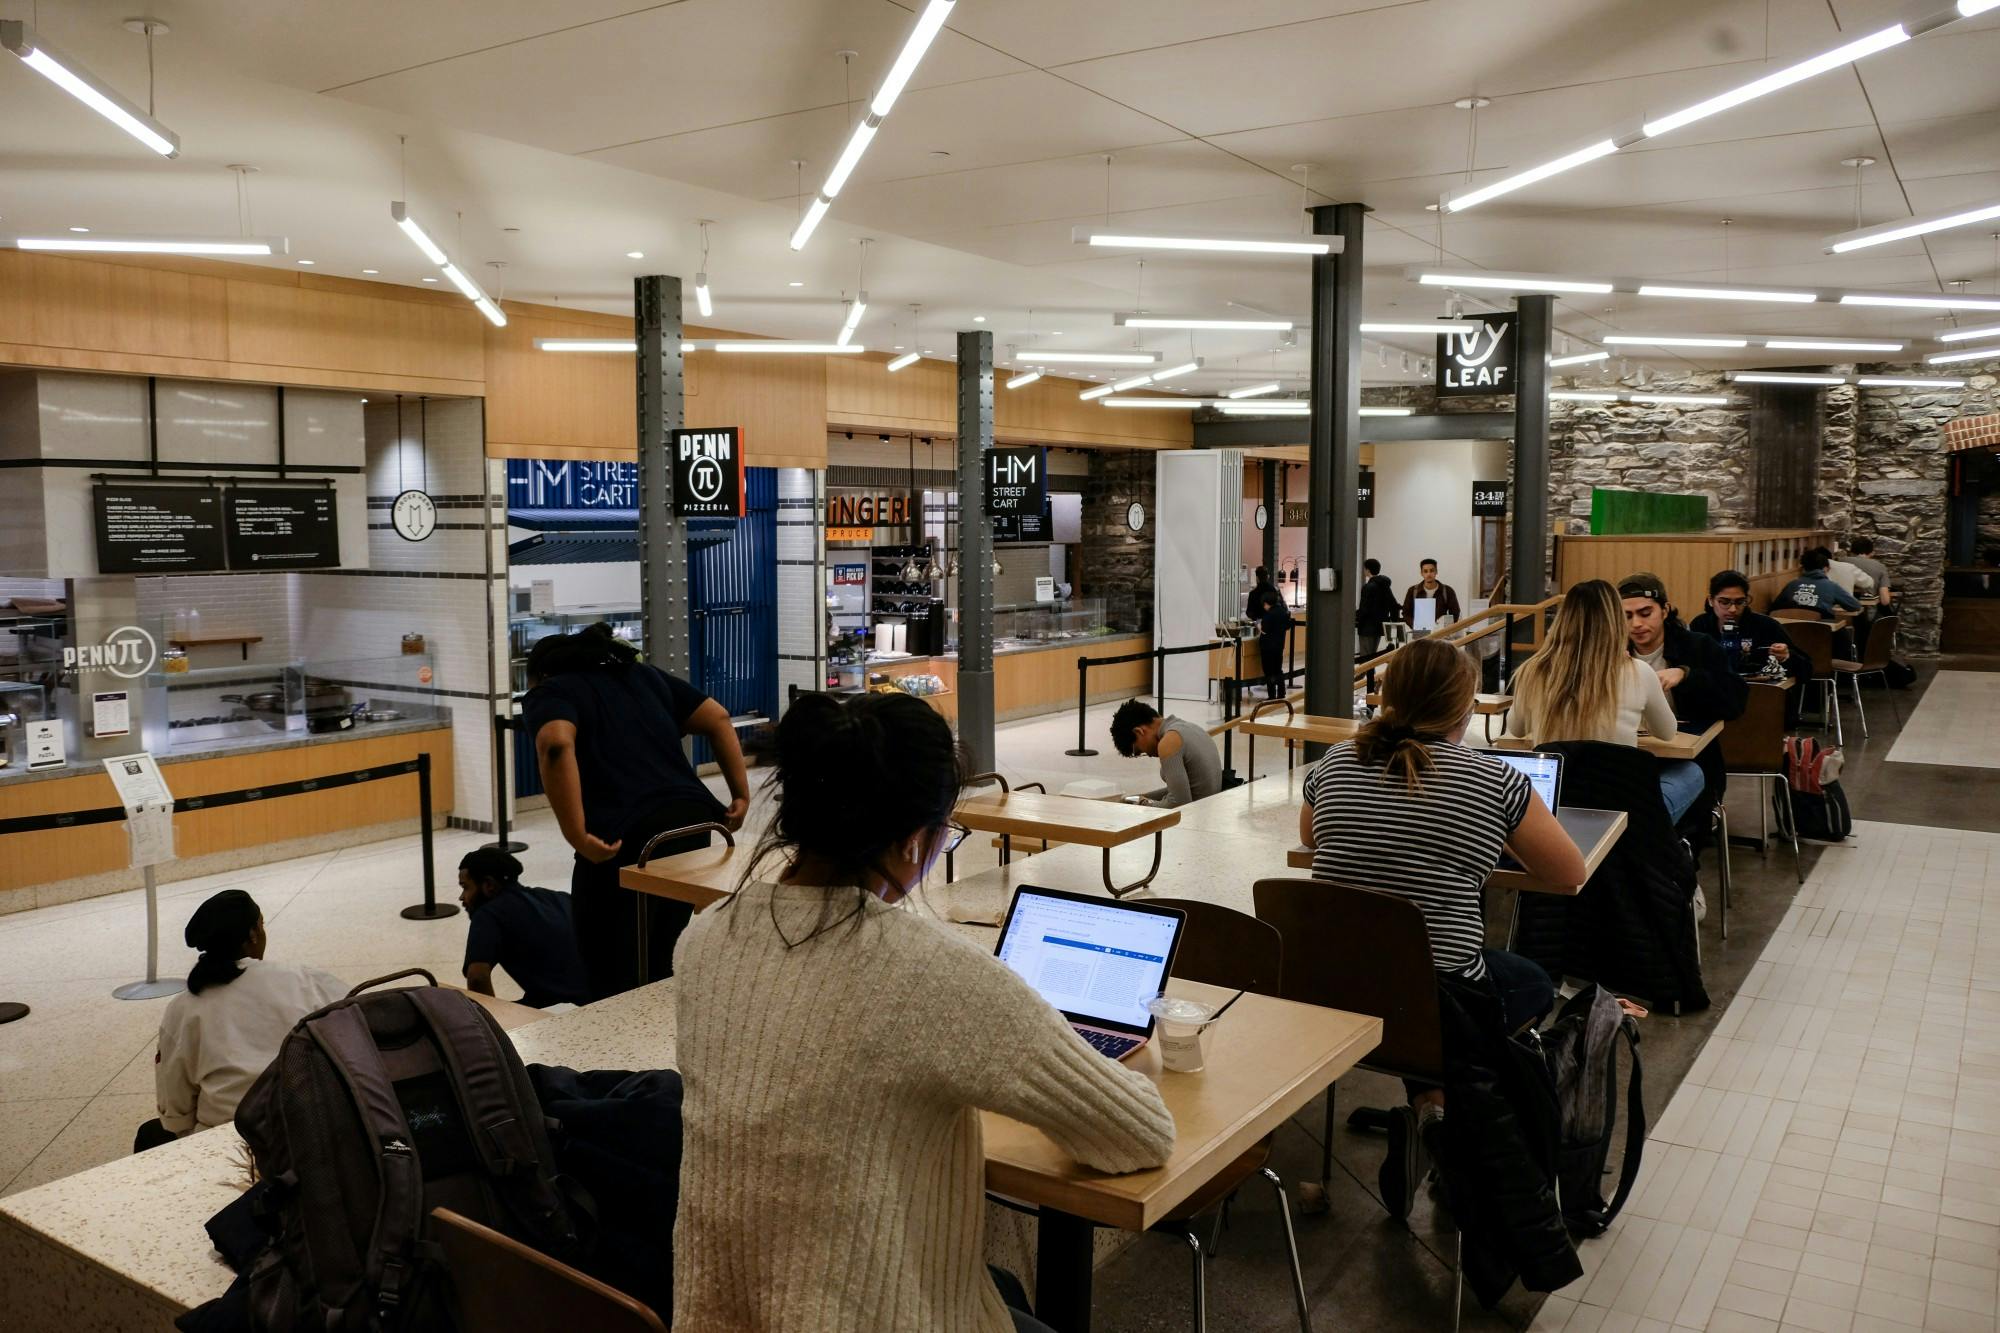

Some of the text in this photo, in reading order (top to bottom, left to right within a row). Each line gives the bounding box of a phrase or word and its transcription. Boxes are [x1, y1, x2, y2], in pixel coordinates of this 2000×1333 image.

[1446, 366, 1508, 387] LEAF
[680, 433, 730, 461] PENN
[580, 461, 638, 482] STREE
[993, 454, 1035, 484] HM
[580, 484, 635, 505] CART
[993, 486, 1027, 497] STREET
[1475, 491, 1493, 501] 34
[684, 503, 729, 511] PIZZERIA
[993, 499, 1018, 508] CART
[846, 572, 857, 581] PICK
[857, 572, 864, 581] UP
[64, 645, 117, 667] PENN
